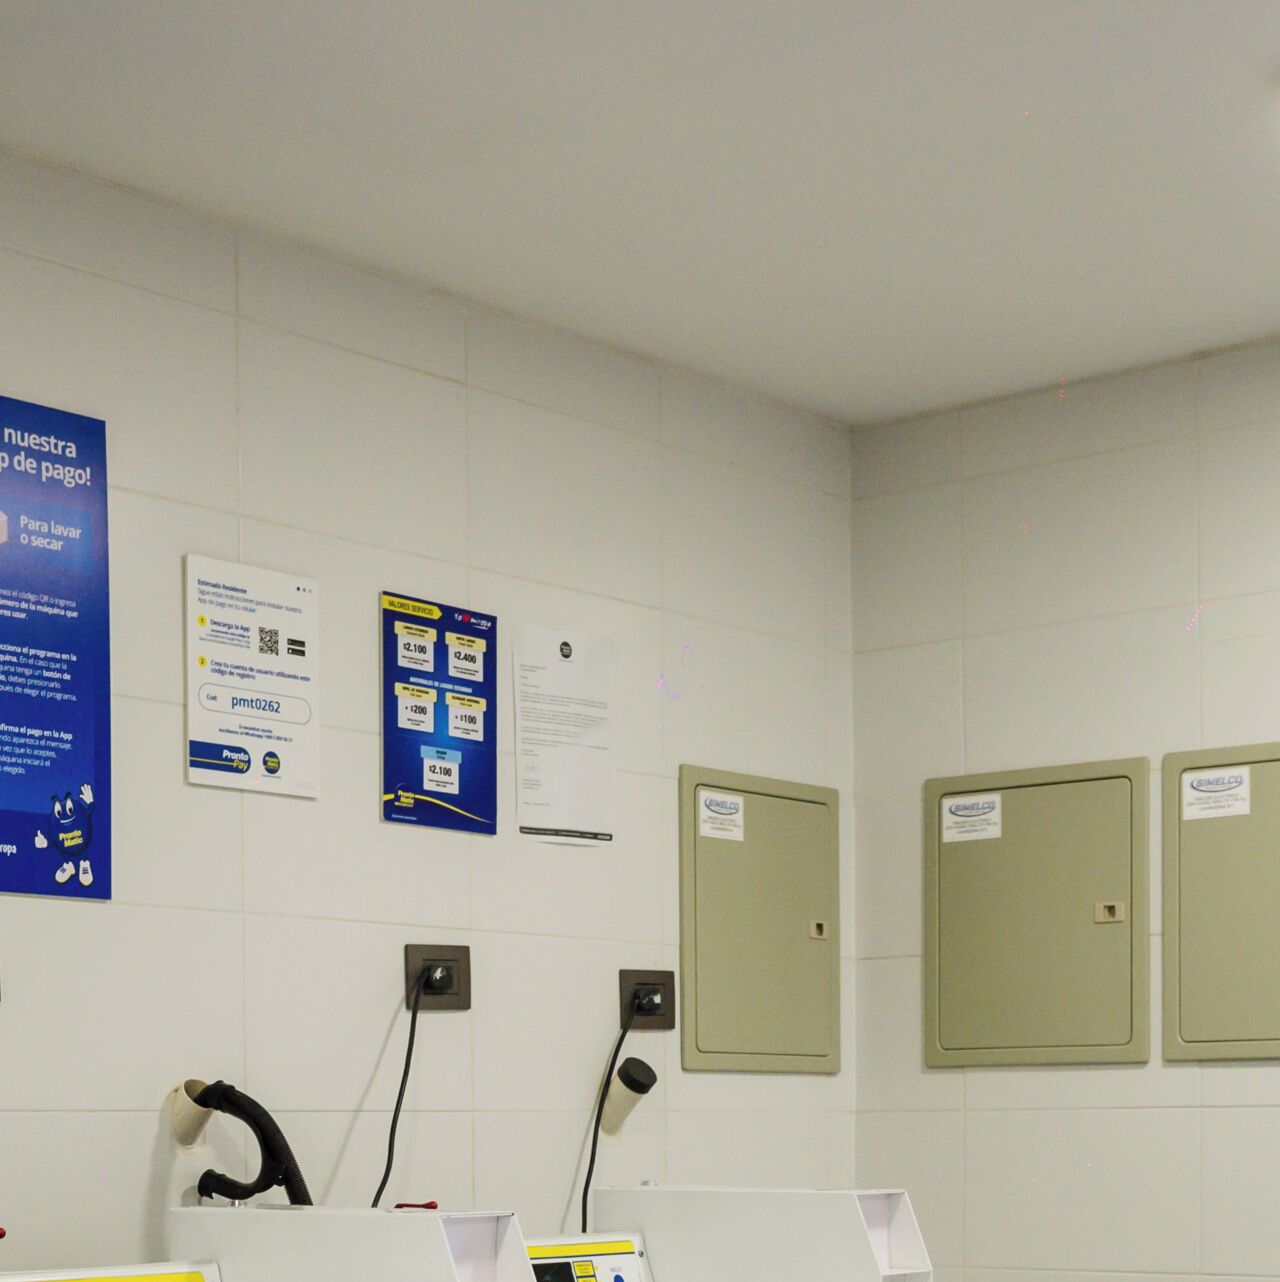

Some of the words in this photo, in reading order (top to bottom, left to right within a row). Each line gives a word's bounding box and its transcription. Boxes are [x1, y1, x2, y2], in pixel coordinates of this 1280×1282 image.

[3, 424, 77, 459] nuestra
[13, 448, 37, 472] de
[41, 457, 92, 488] pago!
[20, 514, 48, 535] Para
[51, 520, 82, 540] lavar
[20, 533, 29, 545] o
[31, 534, 64, 552] secar
[210, 619, 234, 630] Descarga
[403, 642, 427, 655] $2.100
[231, 696, 281, 713] pmt0262
[222, 750, 249, 761] Pronto
[233, 760, 248, 771] Pay
[429, 765, 452, 777] $2.100
[0, 844, 17, 857] ropa
